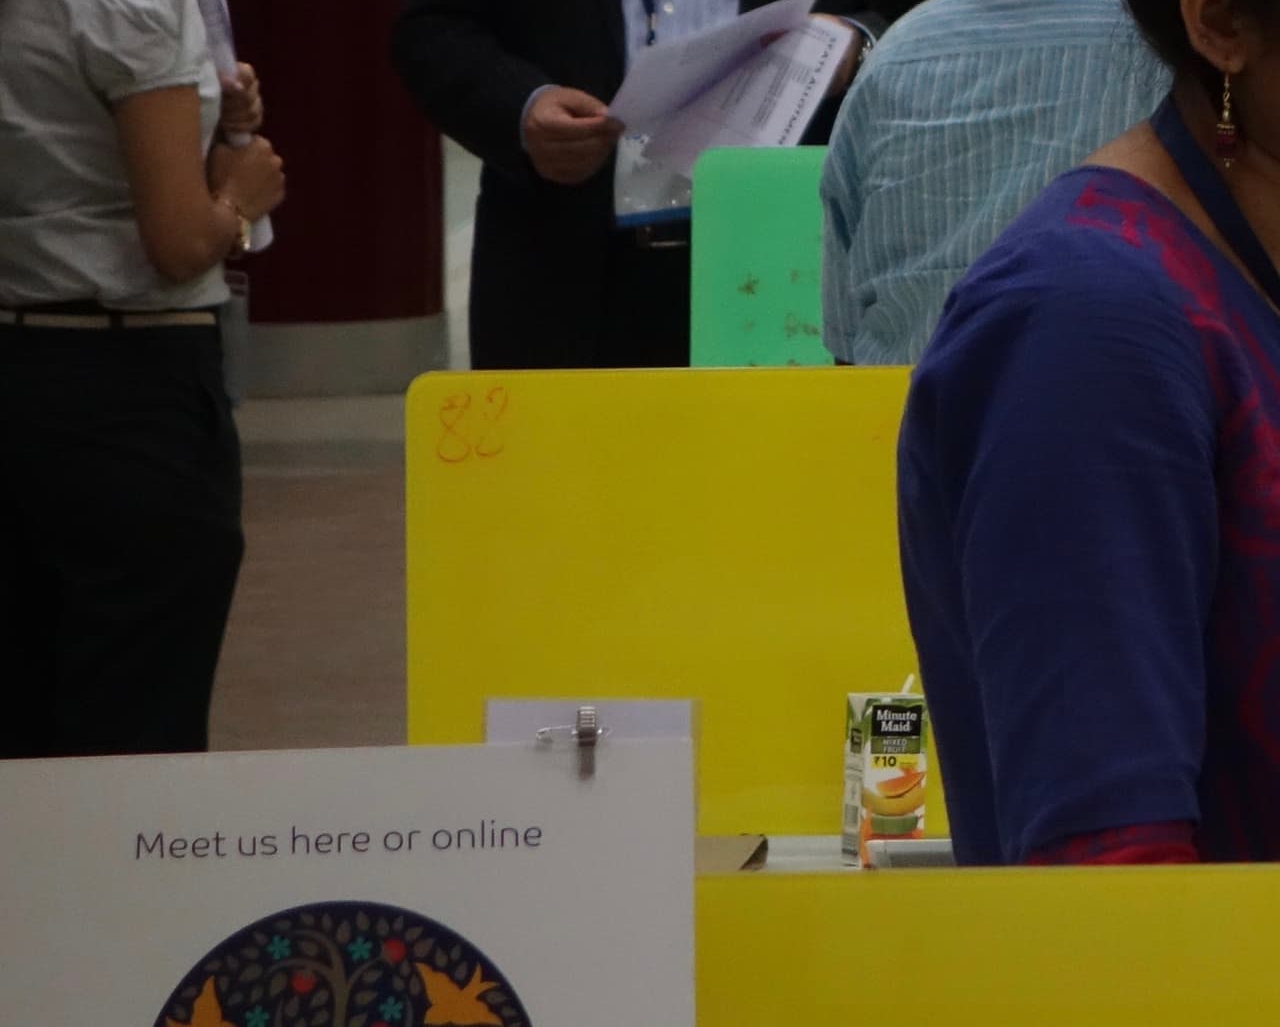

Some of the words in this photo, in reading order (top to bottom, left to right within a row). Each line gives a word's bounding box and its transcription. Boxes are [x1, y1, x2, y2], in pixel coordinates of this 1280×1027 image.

[876, 710, 918, 721] Minute
[881, 721, 912, 732] Maid
[135, 831, 227, 860] Meet
[238, 832, 278, 858] us
[291, 827, 370, 854] here
[382, 830, 421, 852] or
[432, 820, 543, 850] online
